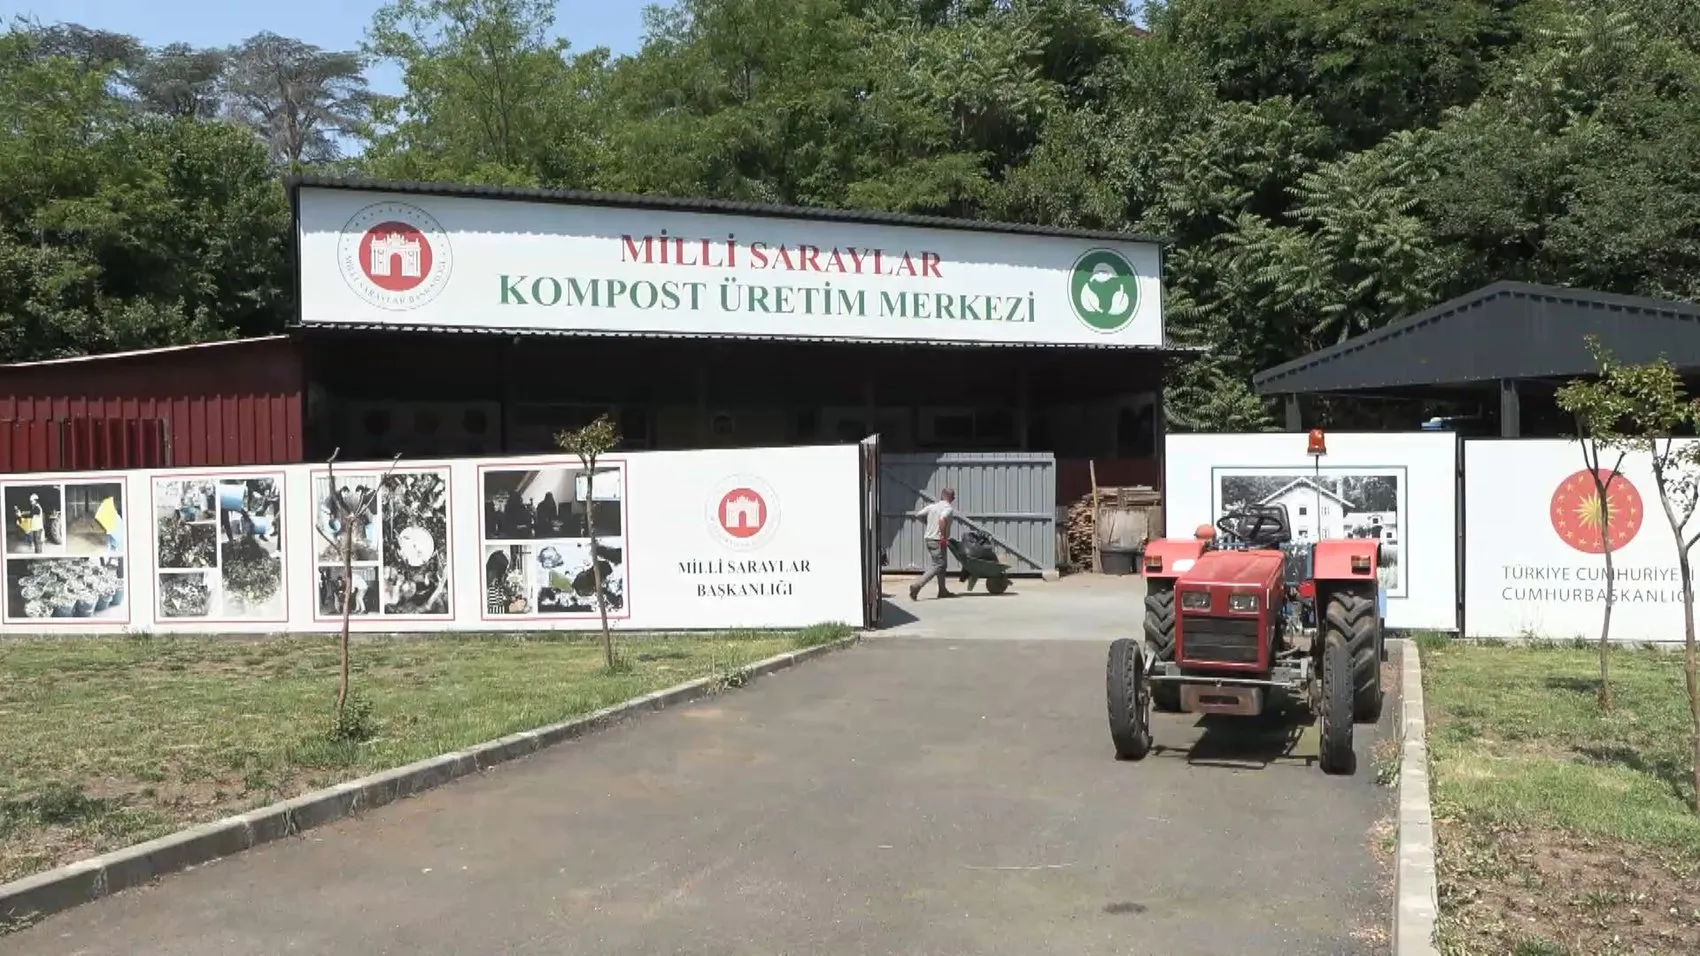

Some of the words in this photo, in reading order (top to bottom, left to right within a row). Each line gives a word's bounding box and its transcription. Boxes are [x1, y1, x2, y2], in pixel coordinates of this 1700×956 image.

[621, 229, 736, 268] MİLLİ
[750, 240, 944, 279] SARAYLAR
[499, 274, 708, 310] KOMPOST
[719, 277, 866, 316] ÜRETİM
[879, 290, 1036, 324] MERKEZİ
[678, 558, 723, 575] MİLLİ
[727, 559, 811, 575] SARAYLAR
[1502, 564, 1570, 581] TÜRKİYE
[1576, 565, 1694, 581] CUMHURİYEİ
[697, 579, 793, 600] BAŞKANLIĞI
